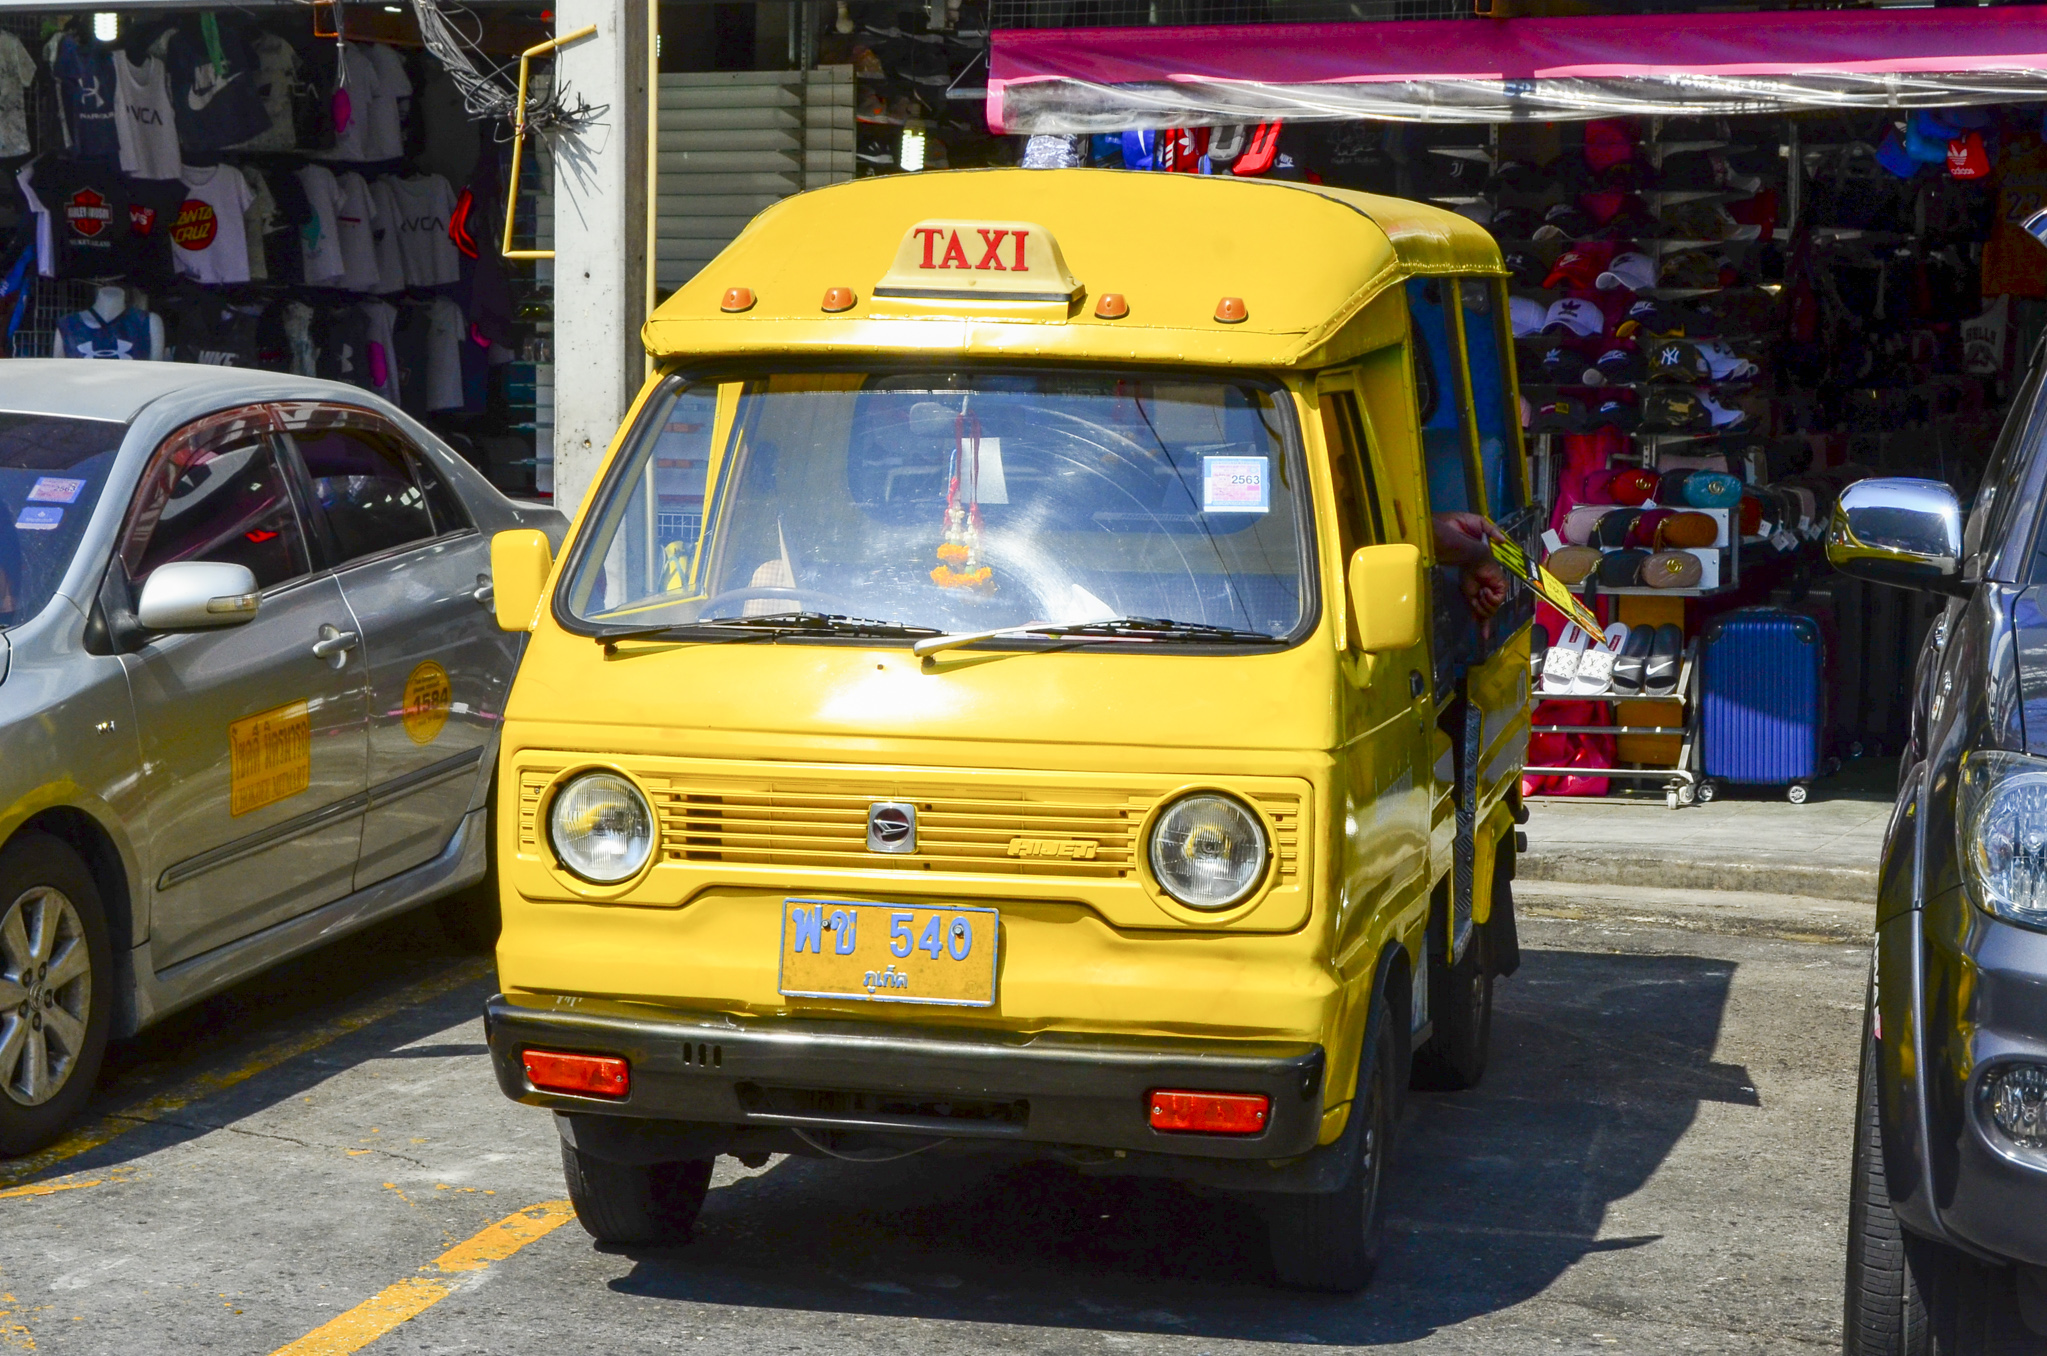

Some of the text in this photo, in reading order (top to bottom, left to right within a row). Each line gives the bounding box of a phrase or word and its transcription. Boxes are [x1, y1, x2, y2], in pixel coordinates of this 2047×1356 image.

[175, 222, 211, 243] CRUZ
[913, 228, 1030, 272] TAXI
[1231, 474, 1261, 485] 2563
[413, 687, 448, 715] 1584
[1007, 837, 1099, 859] HIJET
[890, 912, 973, 961] 540
[863, 964, 908, 994] ภูเก็ต
